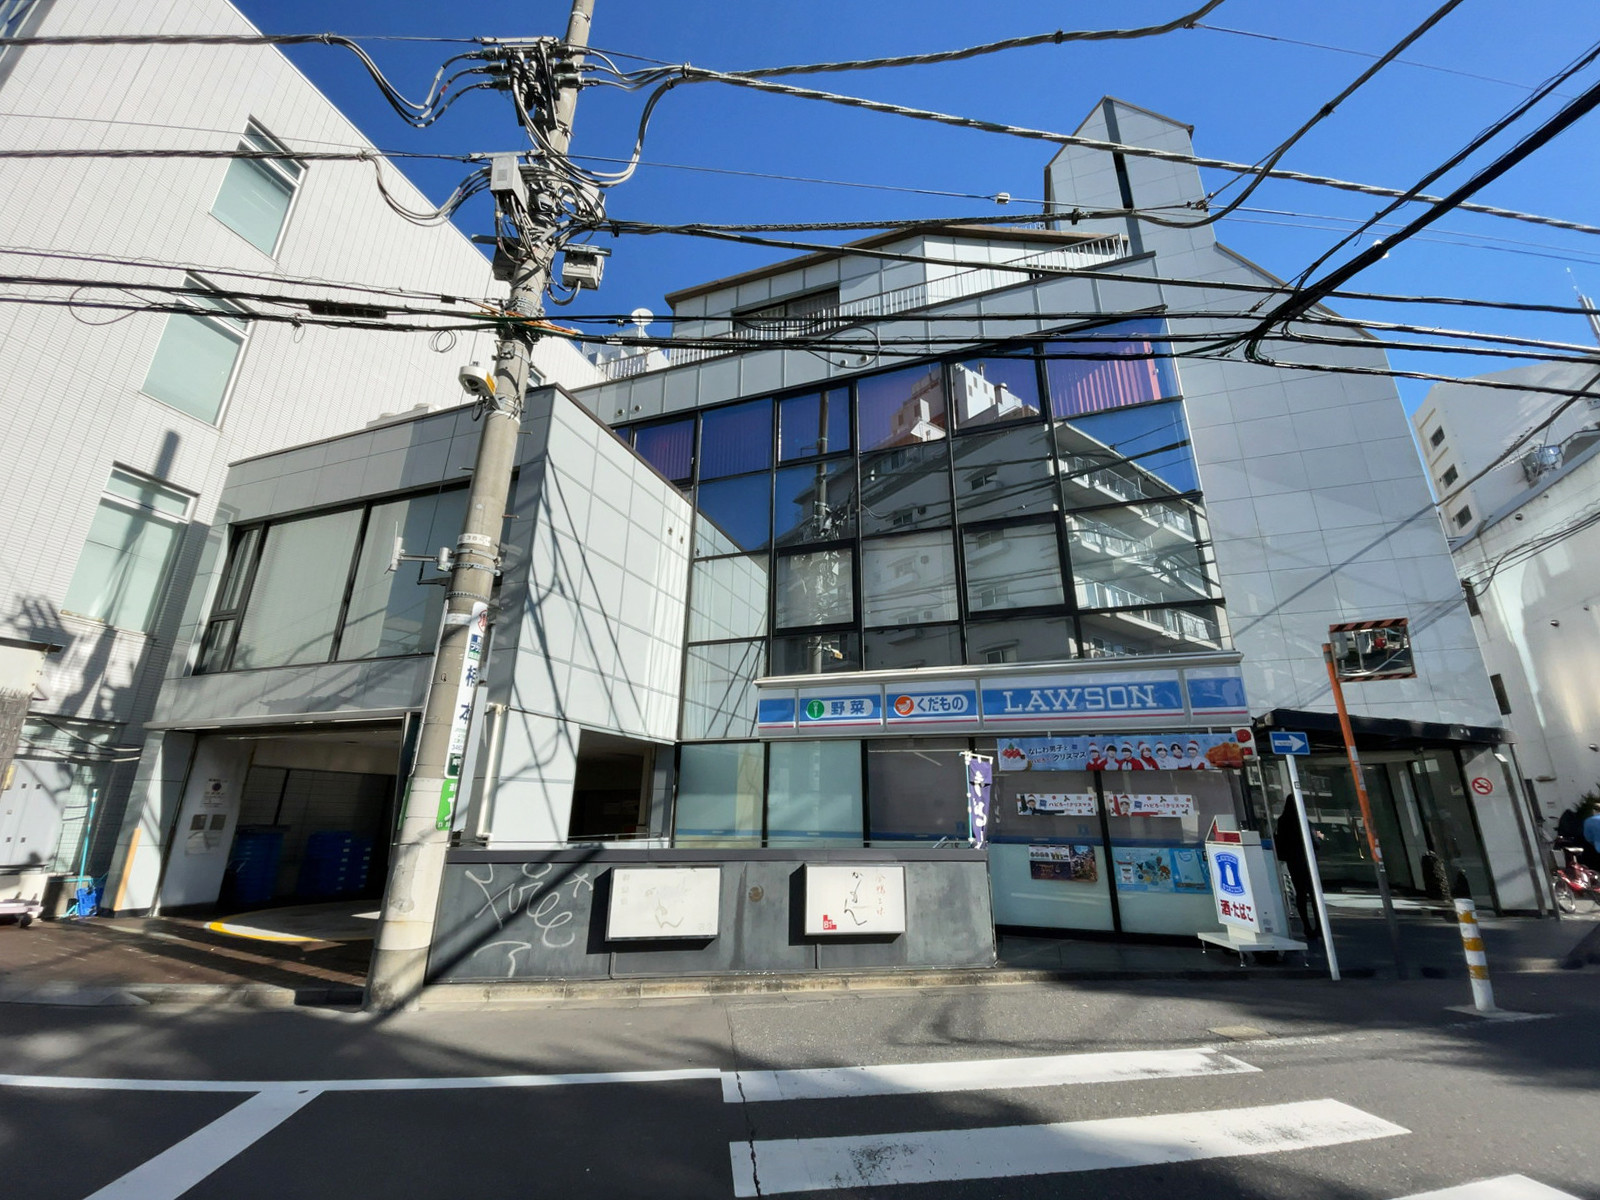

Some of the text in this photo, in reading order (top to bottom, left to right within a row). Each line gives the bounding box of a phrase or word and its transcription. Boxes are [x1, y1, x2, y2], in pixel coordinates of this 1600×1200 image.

[830, 699, 865, 716] 野菜
[916, 696, 965, 713] くだもの
[1003, 685, 1157, 713] LAWSON
